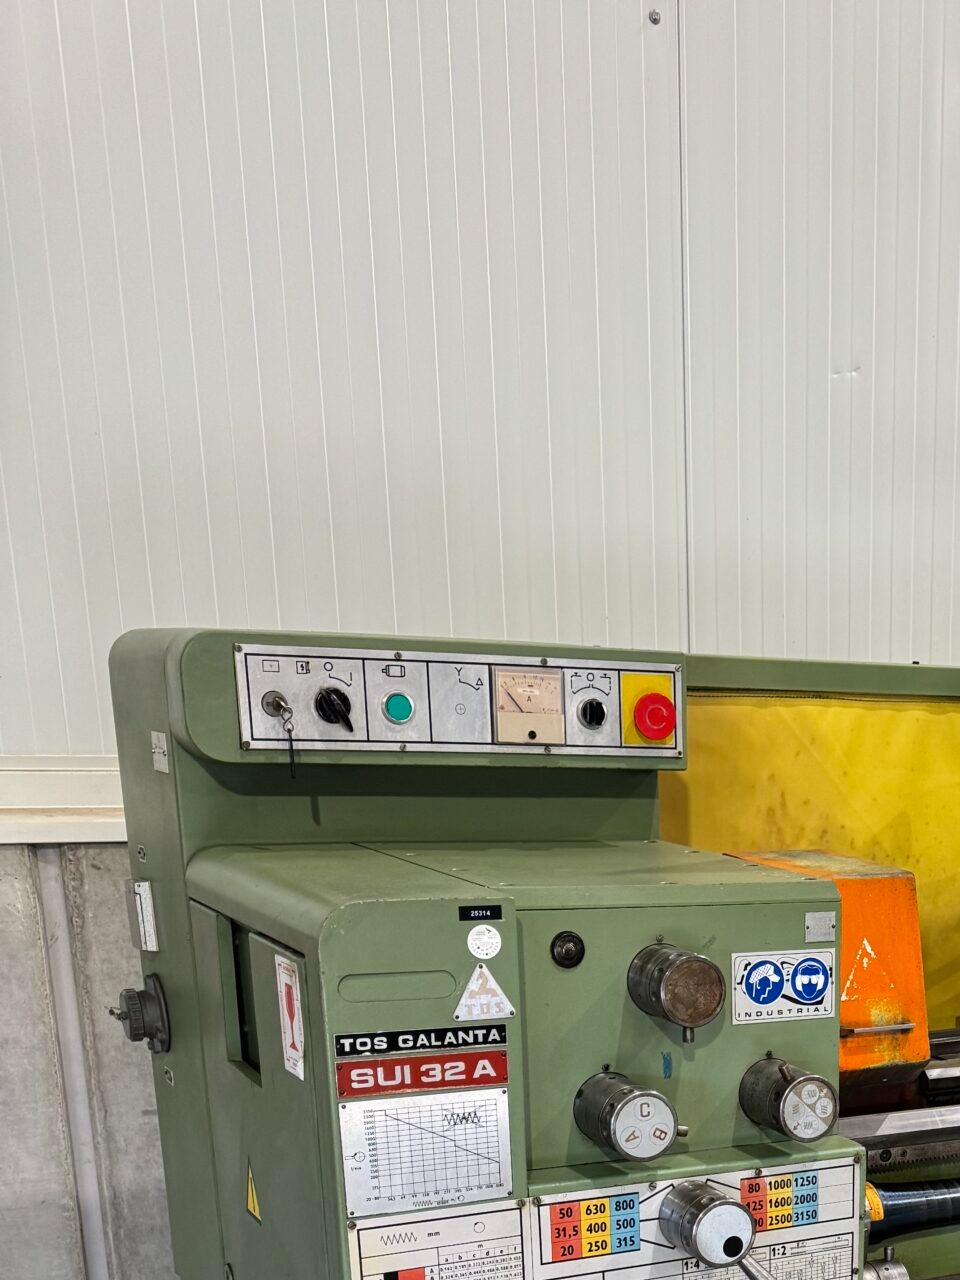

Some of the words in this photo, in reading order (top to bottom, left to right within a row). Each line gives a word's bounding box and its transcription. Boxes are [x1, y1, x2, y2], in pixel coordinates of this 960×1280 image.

[737, 1006, 829, 1019] INDUSTRIAL
[340, 1037, 387, 1052] TOS
[398, 1029, 501, 1048] GALANTA
[351, 1065, 411, 1089] SUI
[420, 1062, 465, 1082] 32
[473, 1060, 496, 1078] A
[640, 1102, 650, 1118] C
[625, 1130, 639, 1142] A
[653, 1128, 667, 1141] B
[748, 1182, 760, 1194] 80
[768, 1178, 792, 1192] 1000
[793, 1175, 817, 1188] 1250
[559, 1206, 573, 1219] 50
[585, 1202, 606, 1216] 630
[614, 1198, 635, 1212] 800
[768, 1196, 792, 1209] 1600
[793, 1192, 818, 1206] 2000
[768, 1212, 793, 1227] 2500
[793, 1209, 817, 1222] 3150
[554, 1225, 579, 1239] 31,5
[586, 1221, 607, 1235] 400
[615, 1217, 636, 1231] 500
[560, 1244, 574, 1257] 20
[586, 1239, 608, 1253] 250
[616, 1235, 636, 1249] 315
[771, 1245, 787, 1257] 1:2
[684, 1260, 700, 1271] 1:4
